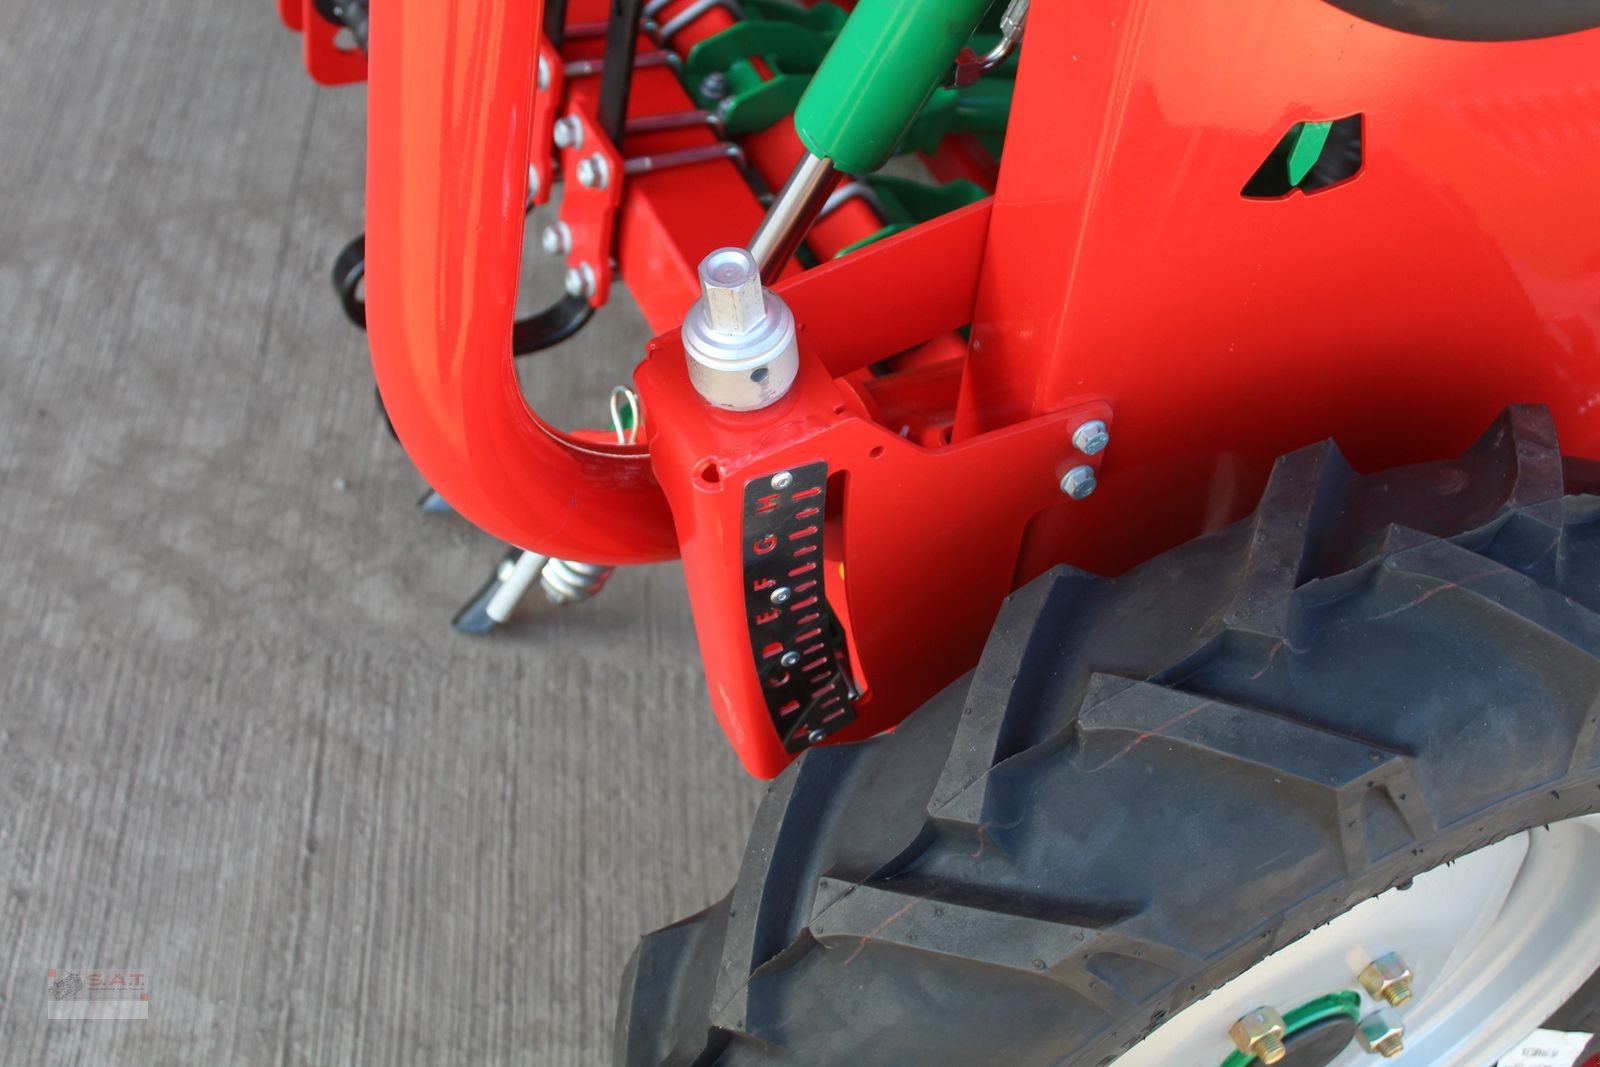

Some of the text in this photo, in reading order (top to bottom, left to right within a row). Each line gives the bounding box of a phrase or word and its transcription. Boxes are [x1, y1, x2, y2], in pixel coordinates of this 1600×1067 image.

[755, 493, 780, 513] H
[752, 533, 778, 555] G
[753, 577, 777, 592] F
[755, 607, 780, 625] E
[761, 641, 784, 659] D
[768, 671, 791, 687] C
